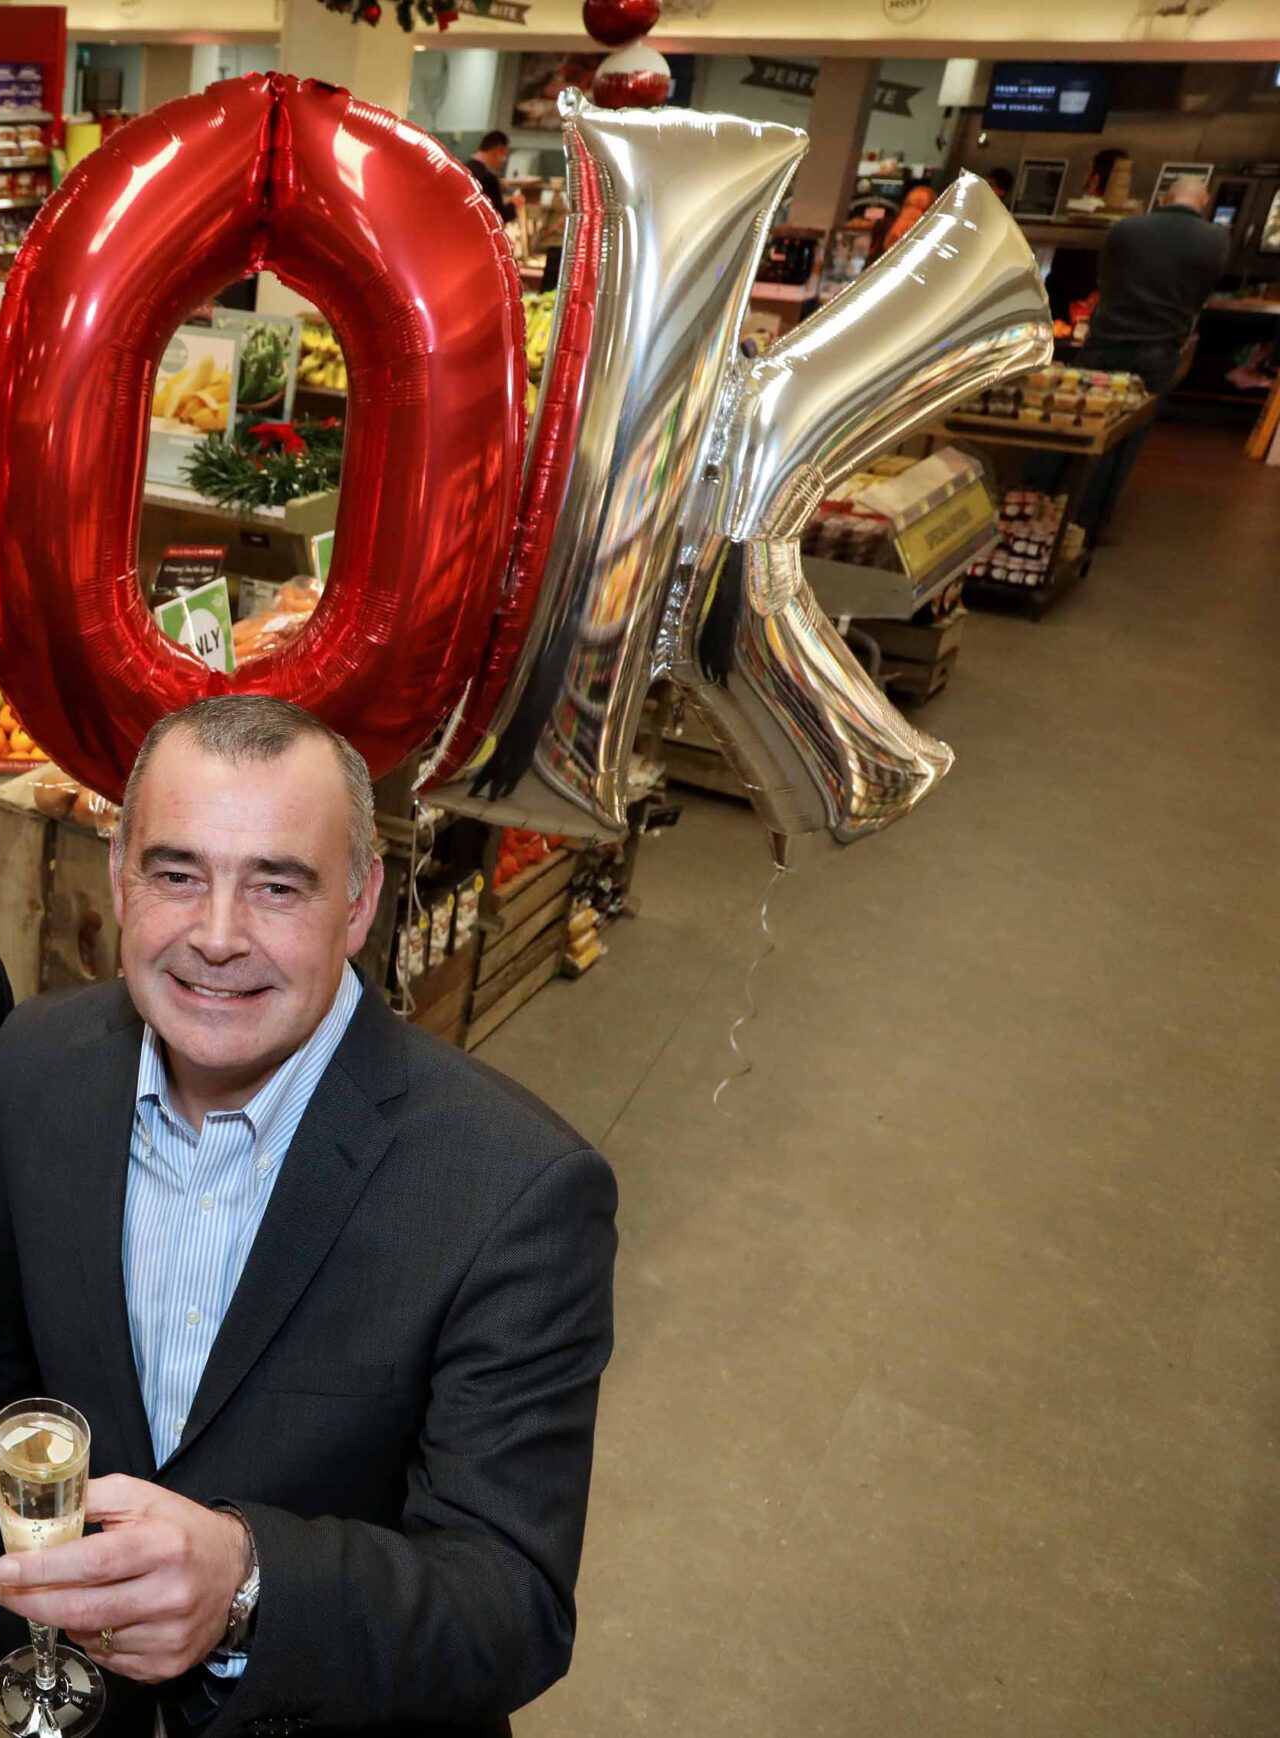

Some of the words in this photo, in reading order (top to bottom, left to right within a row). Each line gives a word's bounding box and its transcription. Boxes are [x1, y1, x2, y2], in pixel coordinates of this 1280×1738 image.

[762, 64, 818, 90] PERF
[873, 87, 899, 106] TE
[186, 626, 220, 657] NLY
